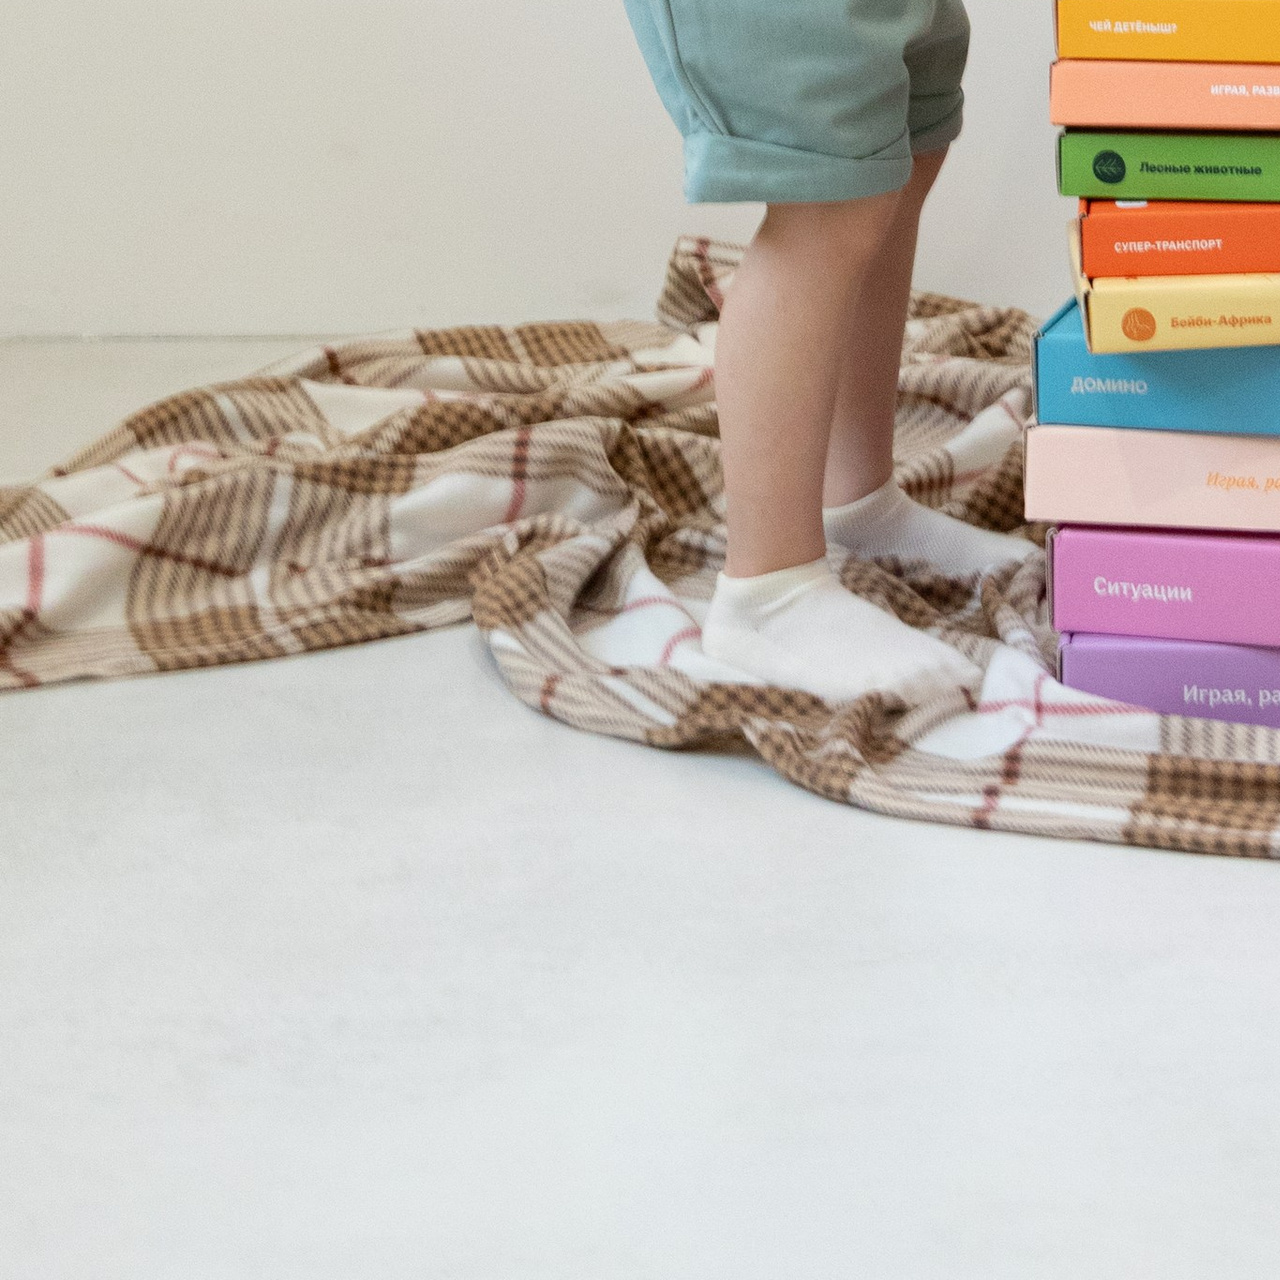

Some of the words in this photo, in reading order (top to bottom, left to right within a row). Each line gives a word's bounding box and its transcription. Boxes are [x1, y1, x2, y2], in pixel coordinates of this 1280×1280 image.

[1089, 19, 1112, 32] ЧЕЙ
[1113, 19, 1178, 35] ДЕТЁНЫШ?
[1210, 83, 1249, 98] ИГРАЯ,
[1139, 160, 1191, 175] Лесные
[1193, 163, 1263, 176] животные
[1114, 237, 1223, 254] СУПЕР-ТРАНСПОРТ
[1170, 311, 1272, 329] Бейби-Африка
[1071, 375, 1148, 395] ДОМИНО
[1206, 470, 1260, 491] Играя,
[1093, 576, 1193, 603] Ситуации
[1182, 684, 1253, 708] Играя,
